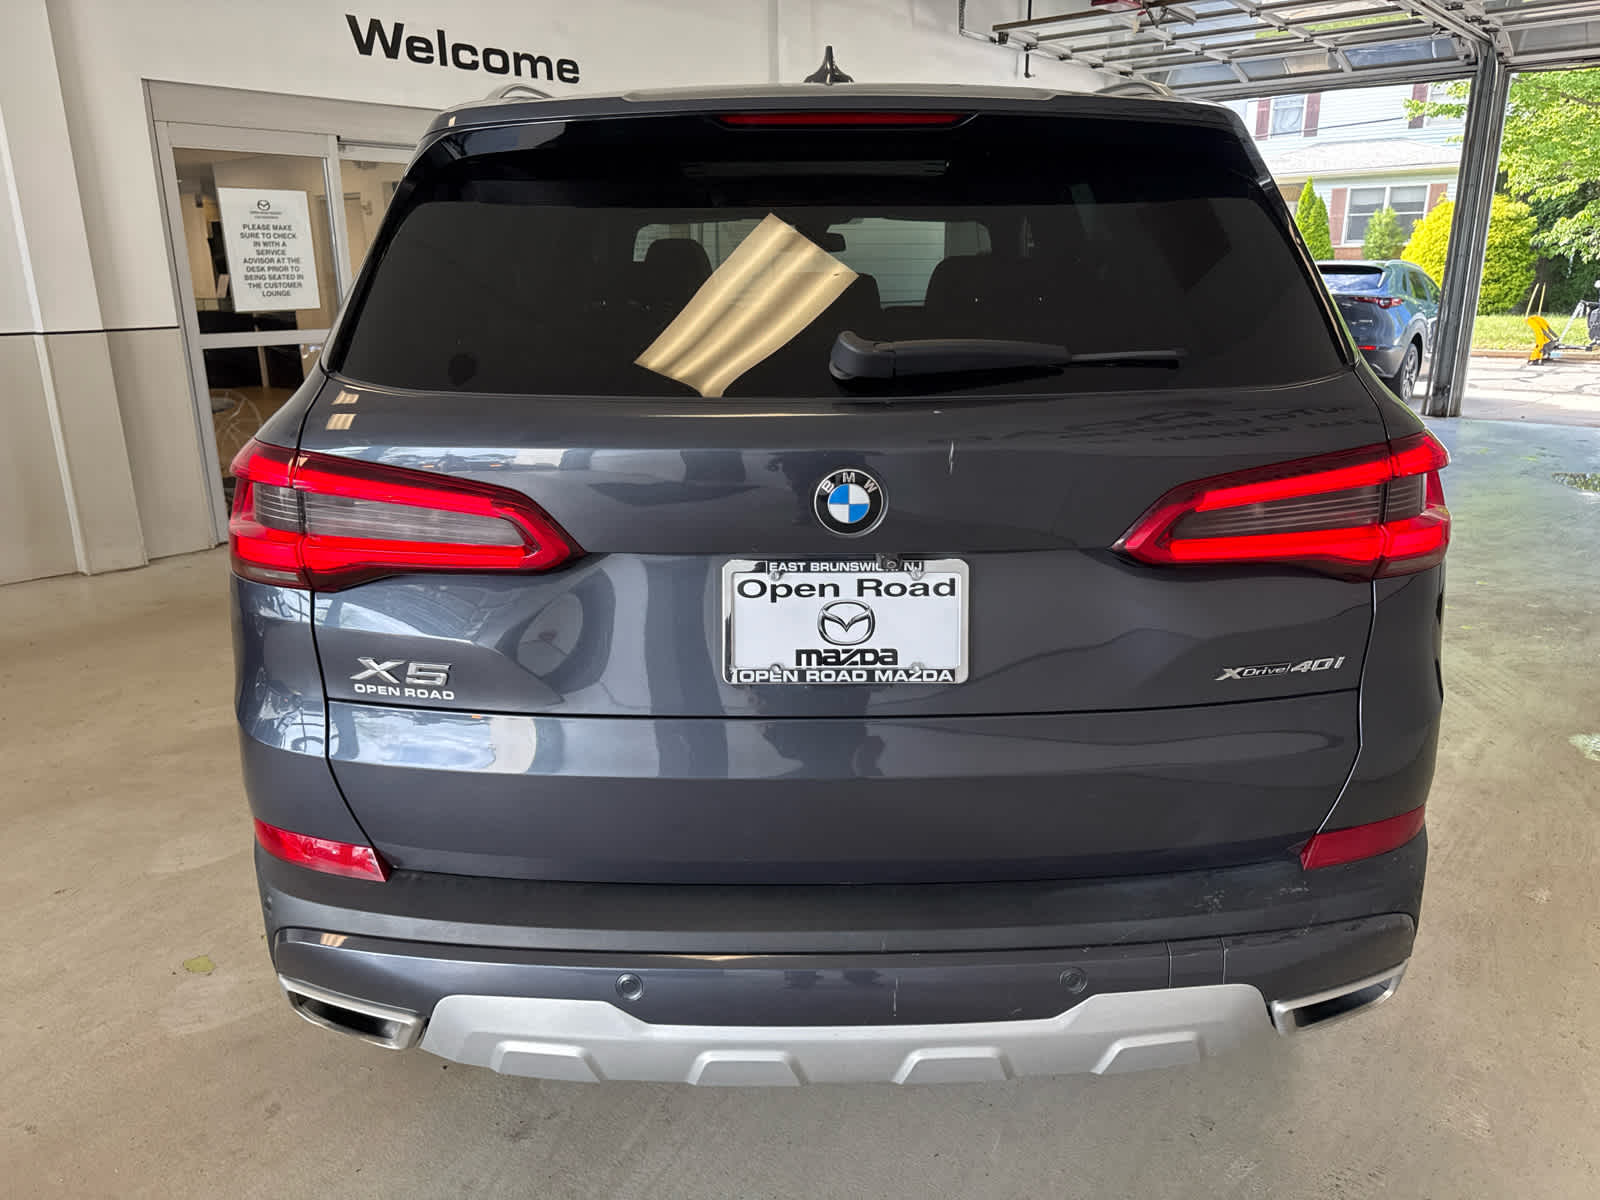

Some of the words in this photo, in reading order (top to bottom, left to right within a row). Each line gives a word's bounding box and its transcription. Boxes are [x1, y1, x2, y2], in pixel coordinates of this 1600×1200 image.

[345, 14, 580, 84] Welcome
[242, 223, 271, 231] PLEASE
[821, 472, 878, 494] BMW
[769, 562, 806, 572] EAST
[737, 578, 840, 603] Open
[857, 578, 955, 597] Road
[739, 669, 798, 682] OPEN
[805, 669, 867, 682] ROAD
[874, 669, 954, 682] MAZDA
[354, 683, 400, 696] OPEN
[404, 687, 455, 700] ROAD
